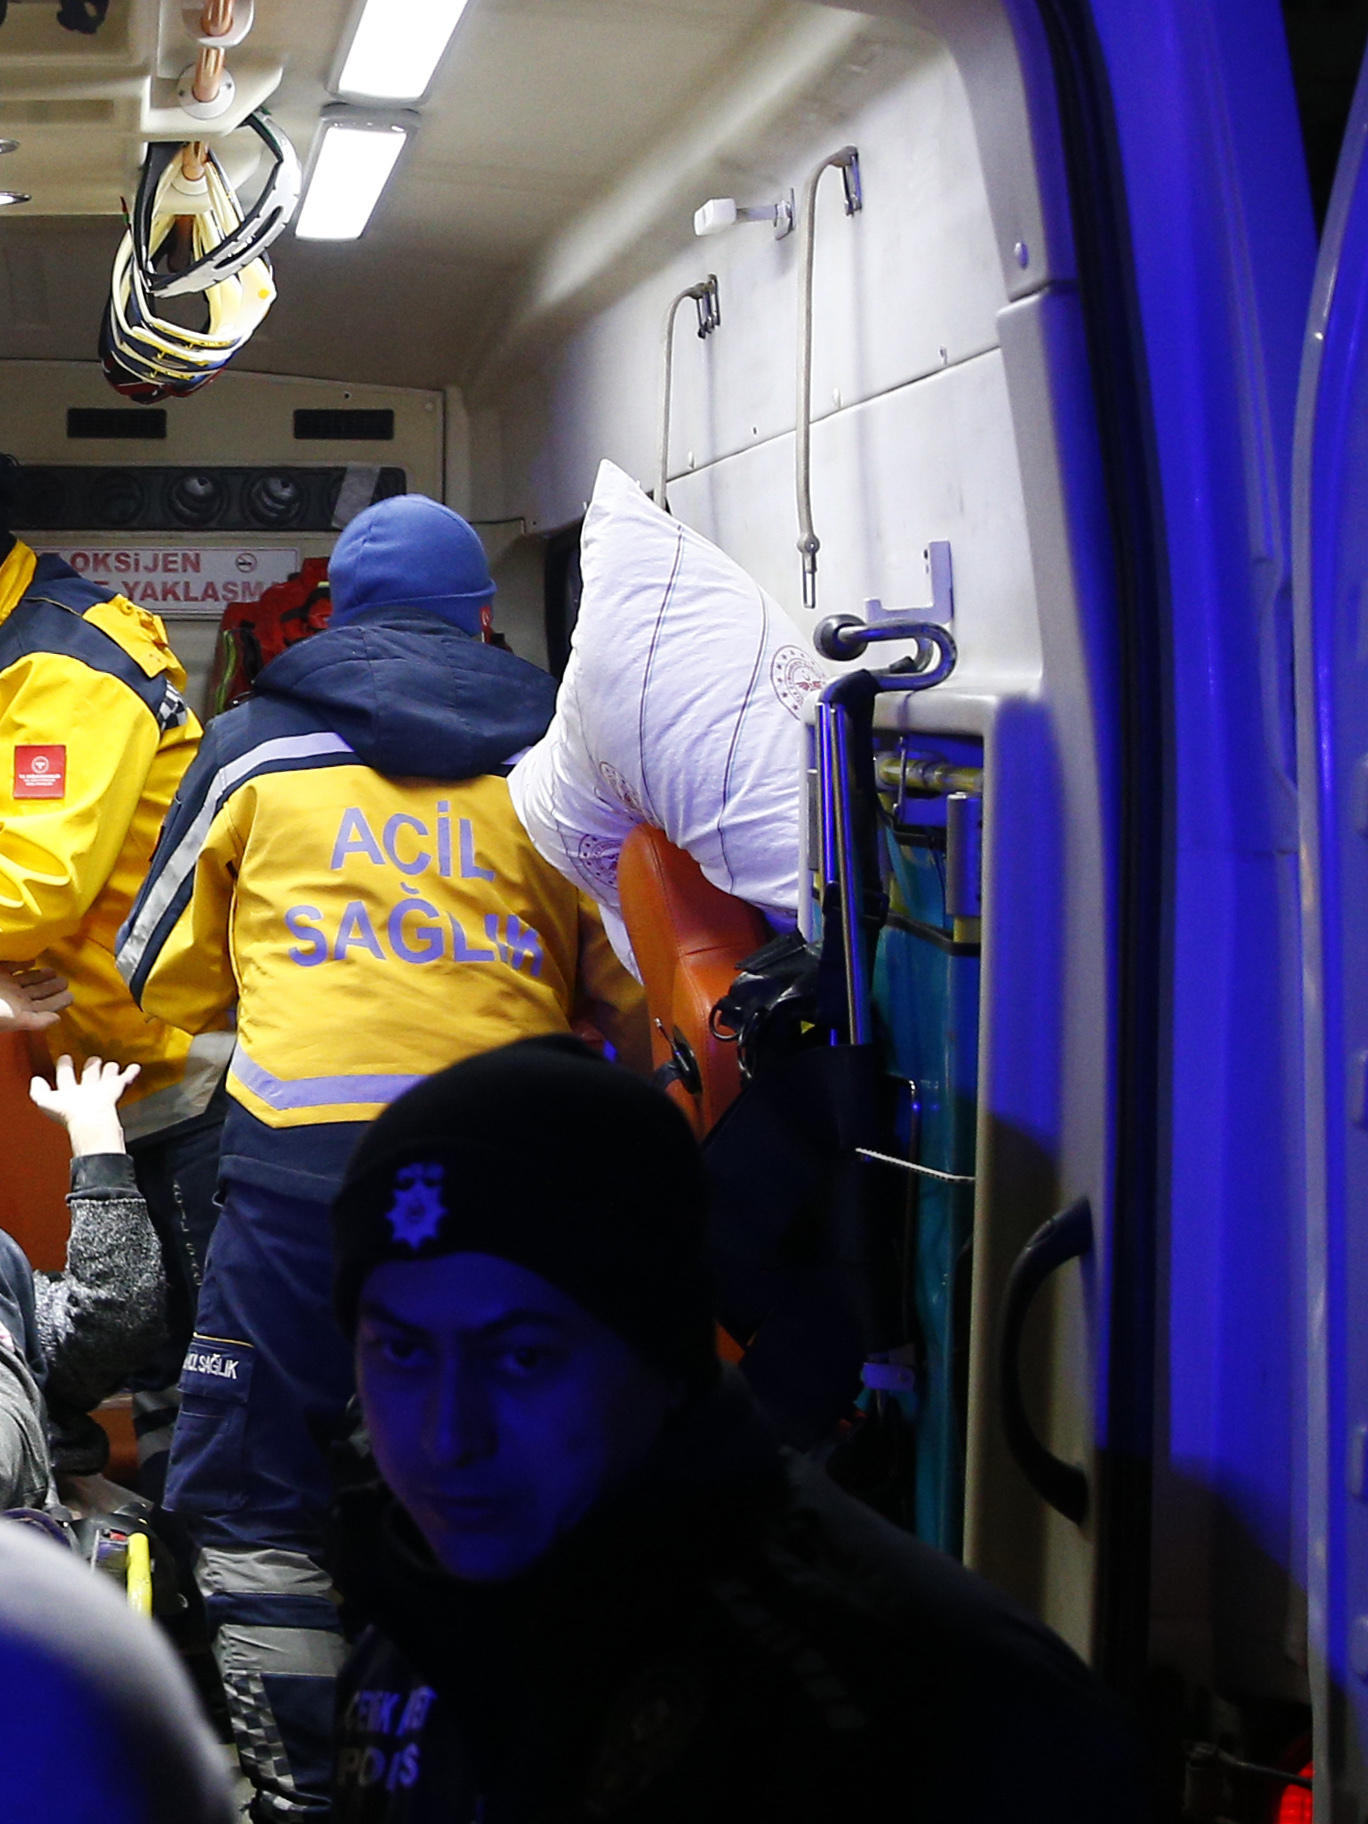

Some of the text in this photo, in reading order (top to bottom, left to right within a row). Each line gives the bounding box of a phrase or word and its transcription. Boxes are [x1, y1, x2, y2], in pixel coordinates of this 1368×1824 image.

[121, 580, 280, 602] YAKLASM
[329, 800, 496, 882] ACİL
[284, 881, 544, 977] SAĞLIK
[197, 1353, 239, 1379] SAĞLIK
